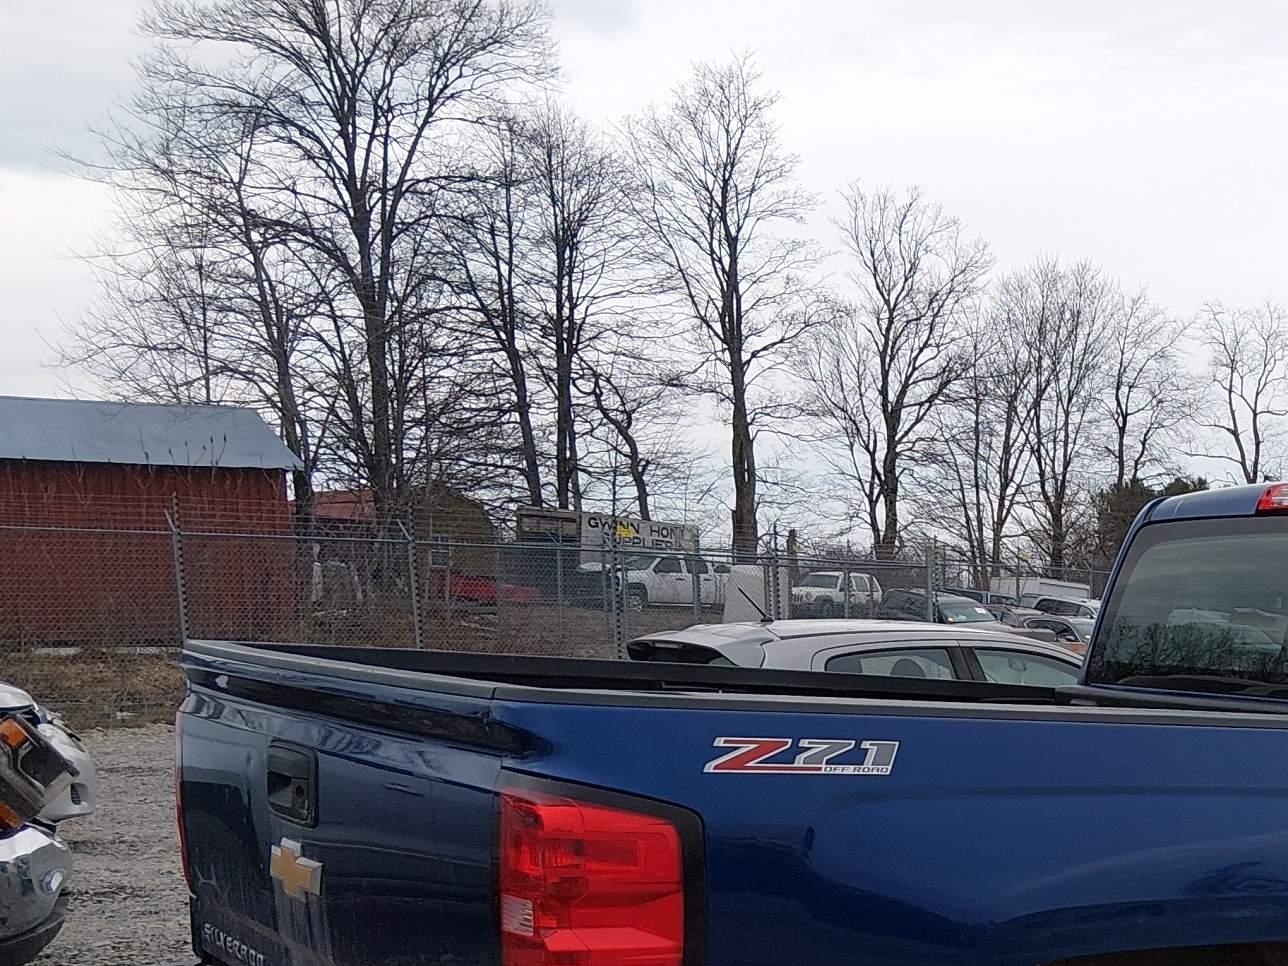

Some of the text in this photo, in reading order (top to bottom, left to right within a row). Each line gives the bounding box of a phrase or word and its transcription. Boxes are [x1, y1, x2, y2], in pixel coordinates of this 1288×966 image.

[587, 516, 641, 535] GWNN
[703, 736, 900, 775] Z71
[823, 765, 890, 774] OFF ROAD
